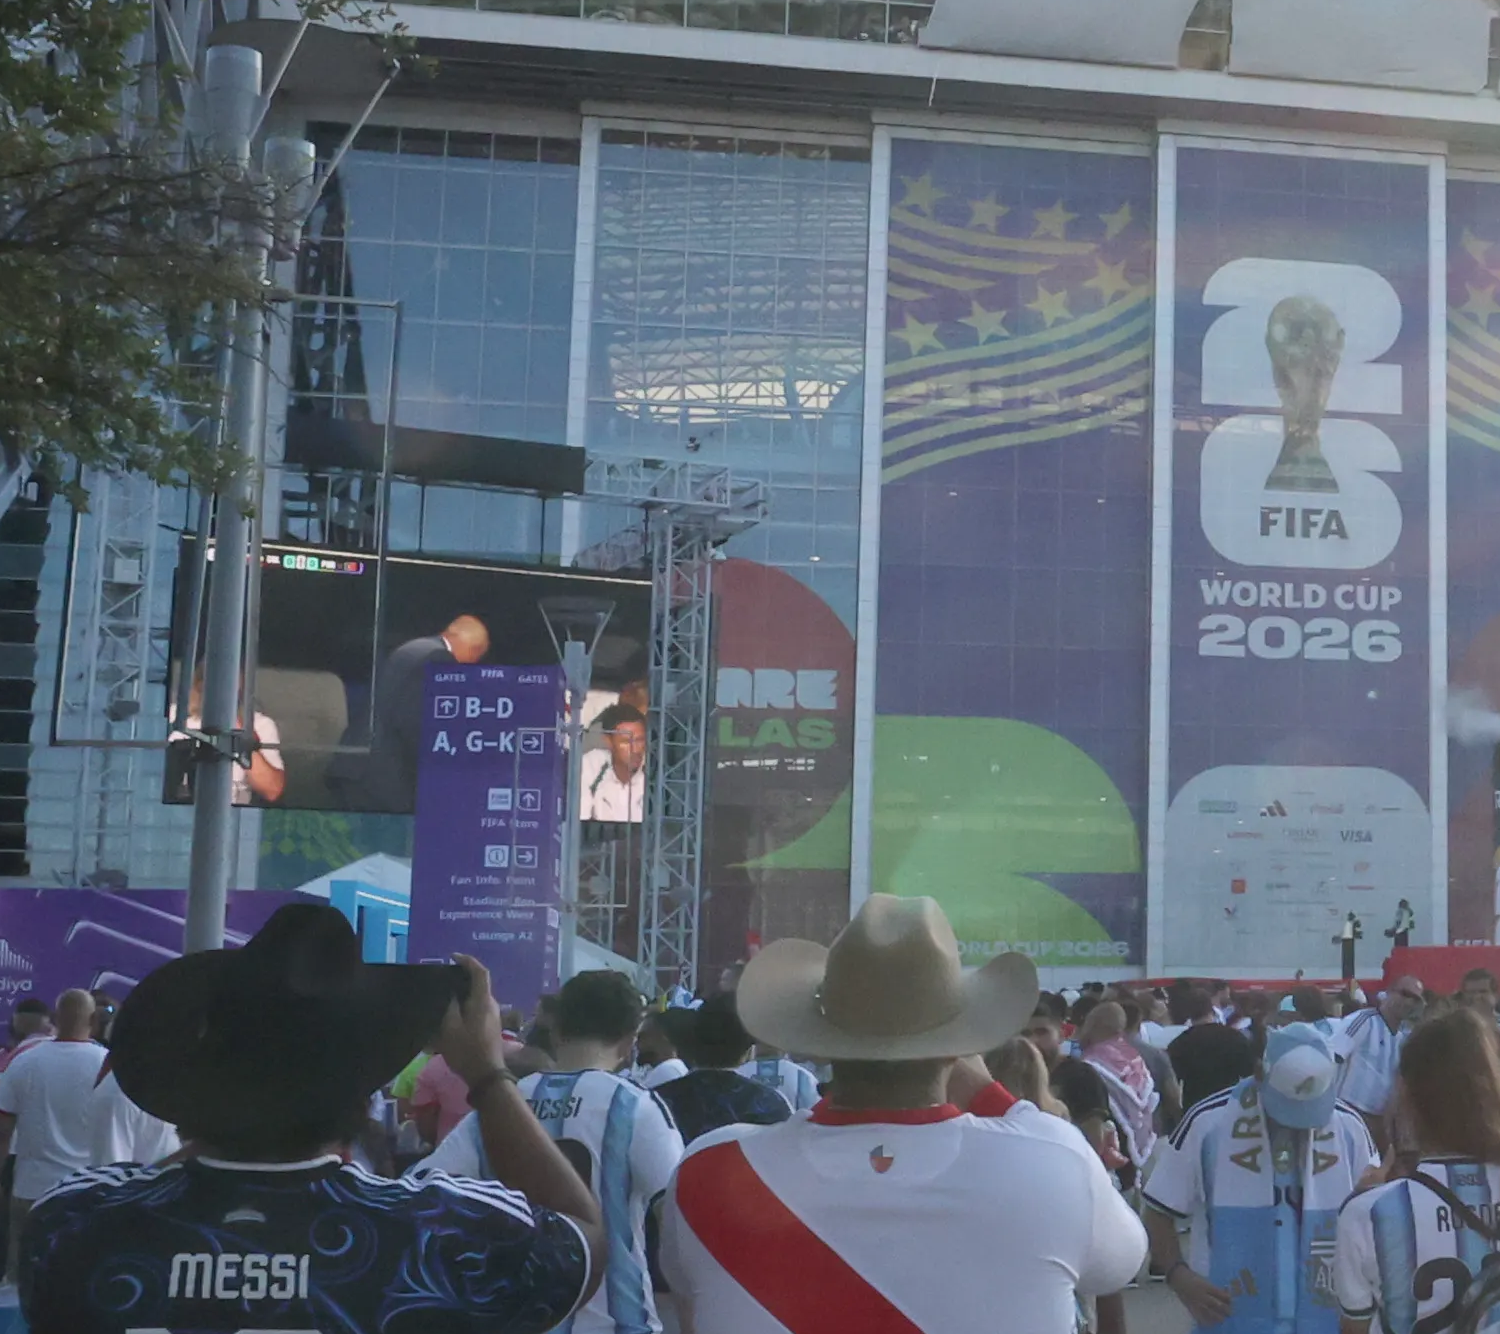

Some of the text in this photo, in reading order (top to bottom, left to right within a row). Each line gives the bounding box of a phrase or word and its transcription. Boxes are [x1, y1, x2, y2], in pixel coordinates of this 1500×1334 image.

[1259, 507, 1350, 540] FIFA
[1200, 578, 1403, 613] WORLD CUP
[1198, 614, 1402, 662] 2026
[481, 669, 504, 678] FIFA
[432, 731, 457, 756] A,
[718, 717, 837, 750] LAS
[1340, 830, 1373, 842] VISA
[957, 941, 1129, 956] ORLD CUP 2026
[168, 1253, 310, 1300] MESSI
